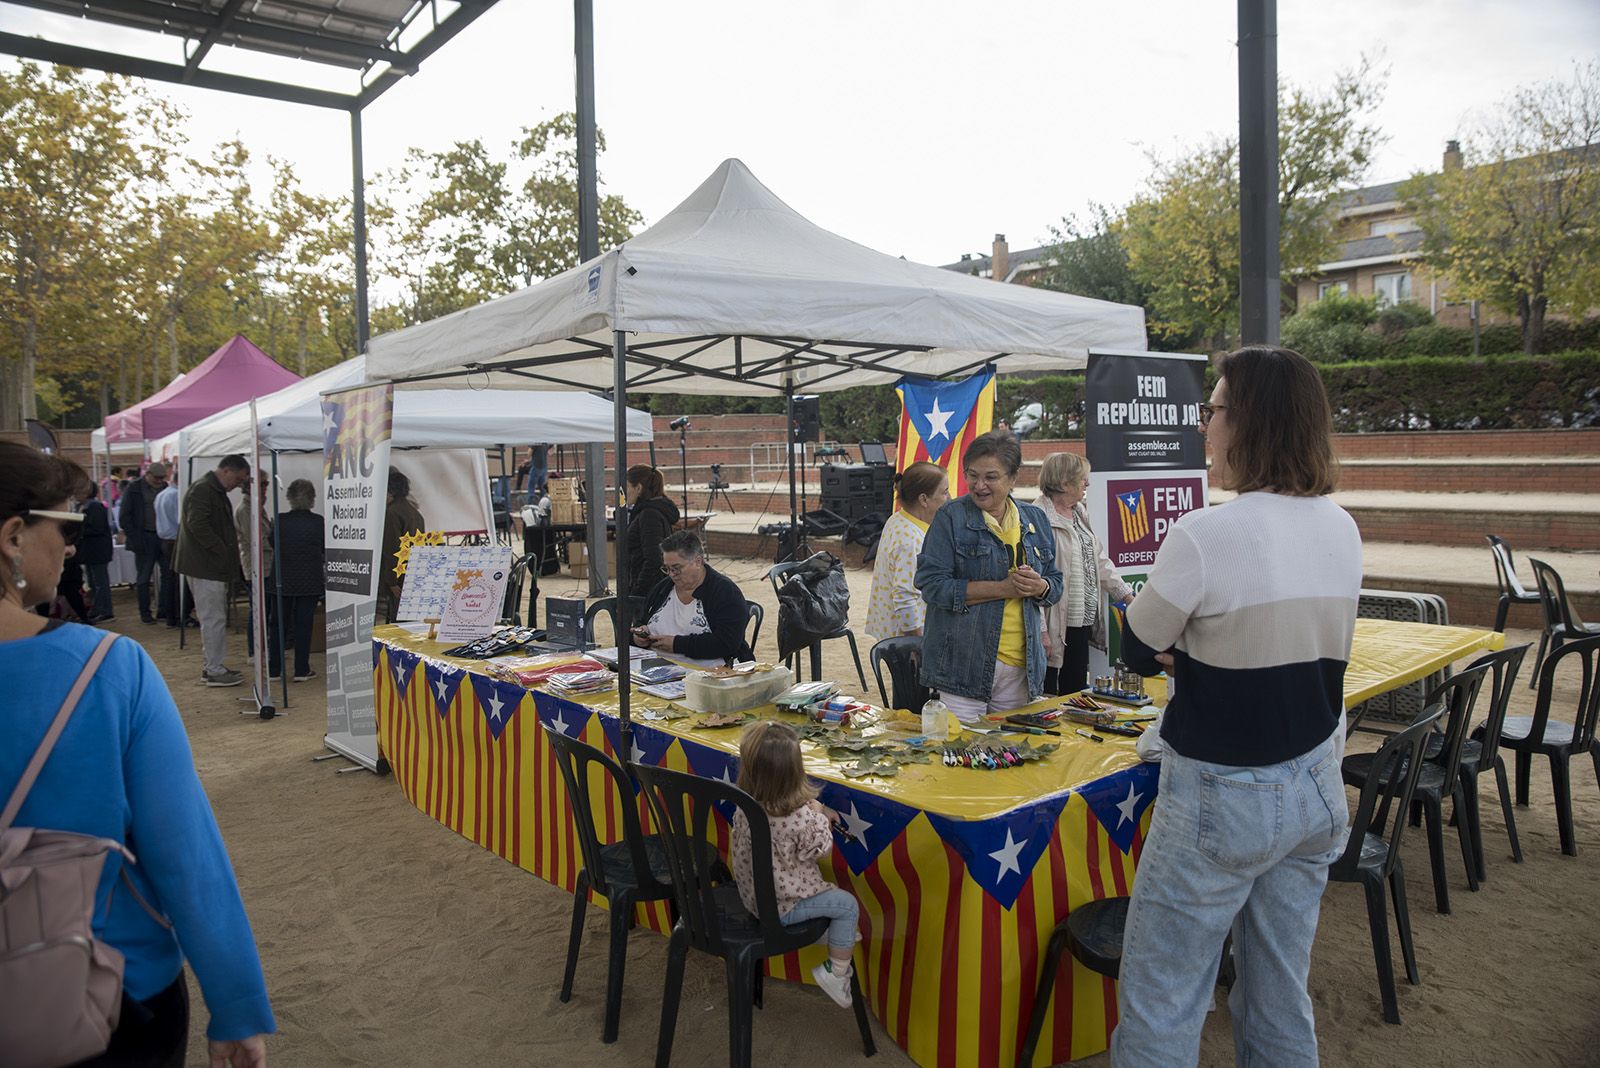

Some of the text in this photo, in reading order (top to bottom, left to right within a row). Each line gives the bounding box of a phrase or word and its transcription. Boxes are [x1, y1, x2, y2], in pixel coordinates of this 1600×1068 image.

[1137, 375, 1167, 398] FEM
[1097, 399, 1200, 426] REPÚBLICA JA!
[1128, 440, 1180, 451] assemblea.cat
[328, 438, 375, 480] ANC
[327, 482, 373, 500] Assemblea
[1154, 486, 1193, 512] FEM
[332, 503, 368, 520] Nacional
[332, 524, 366, 540] Catalana
[327, 560, 370, 575] assemblea.cat
